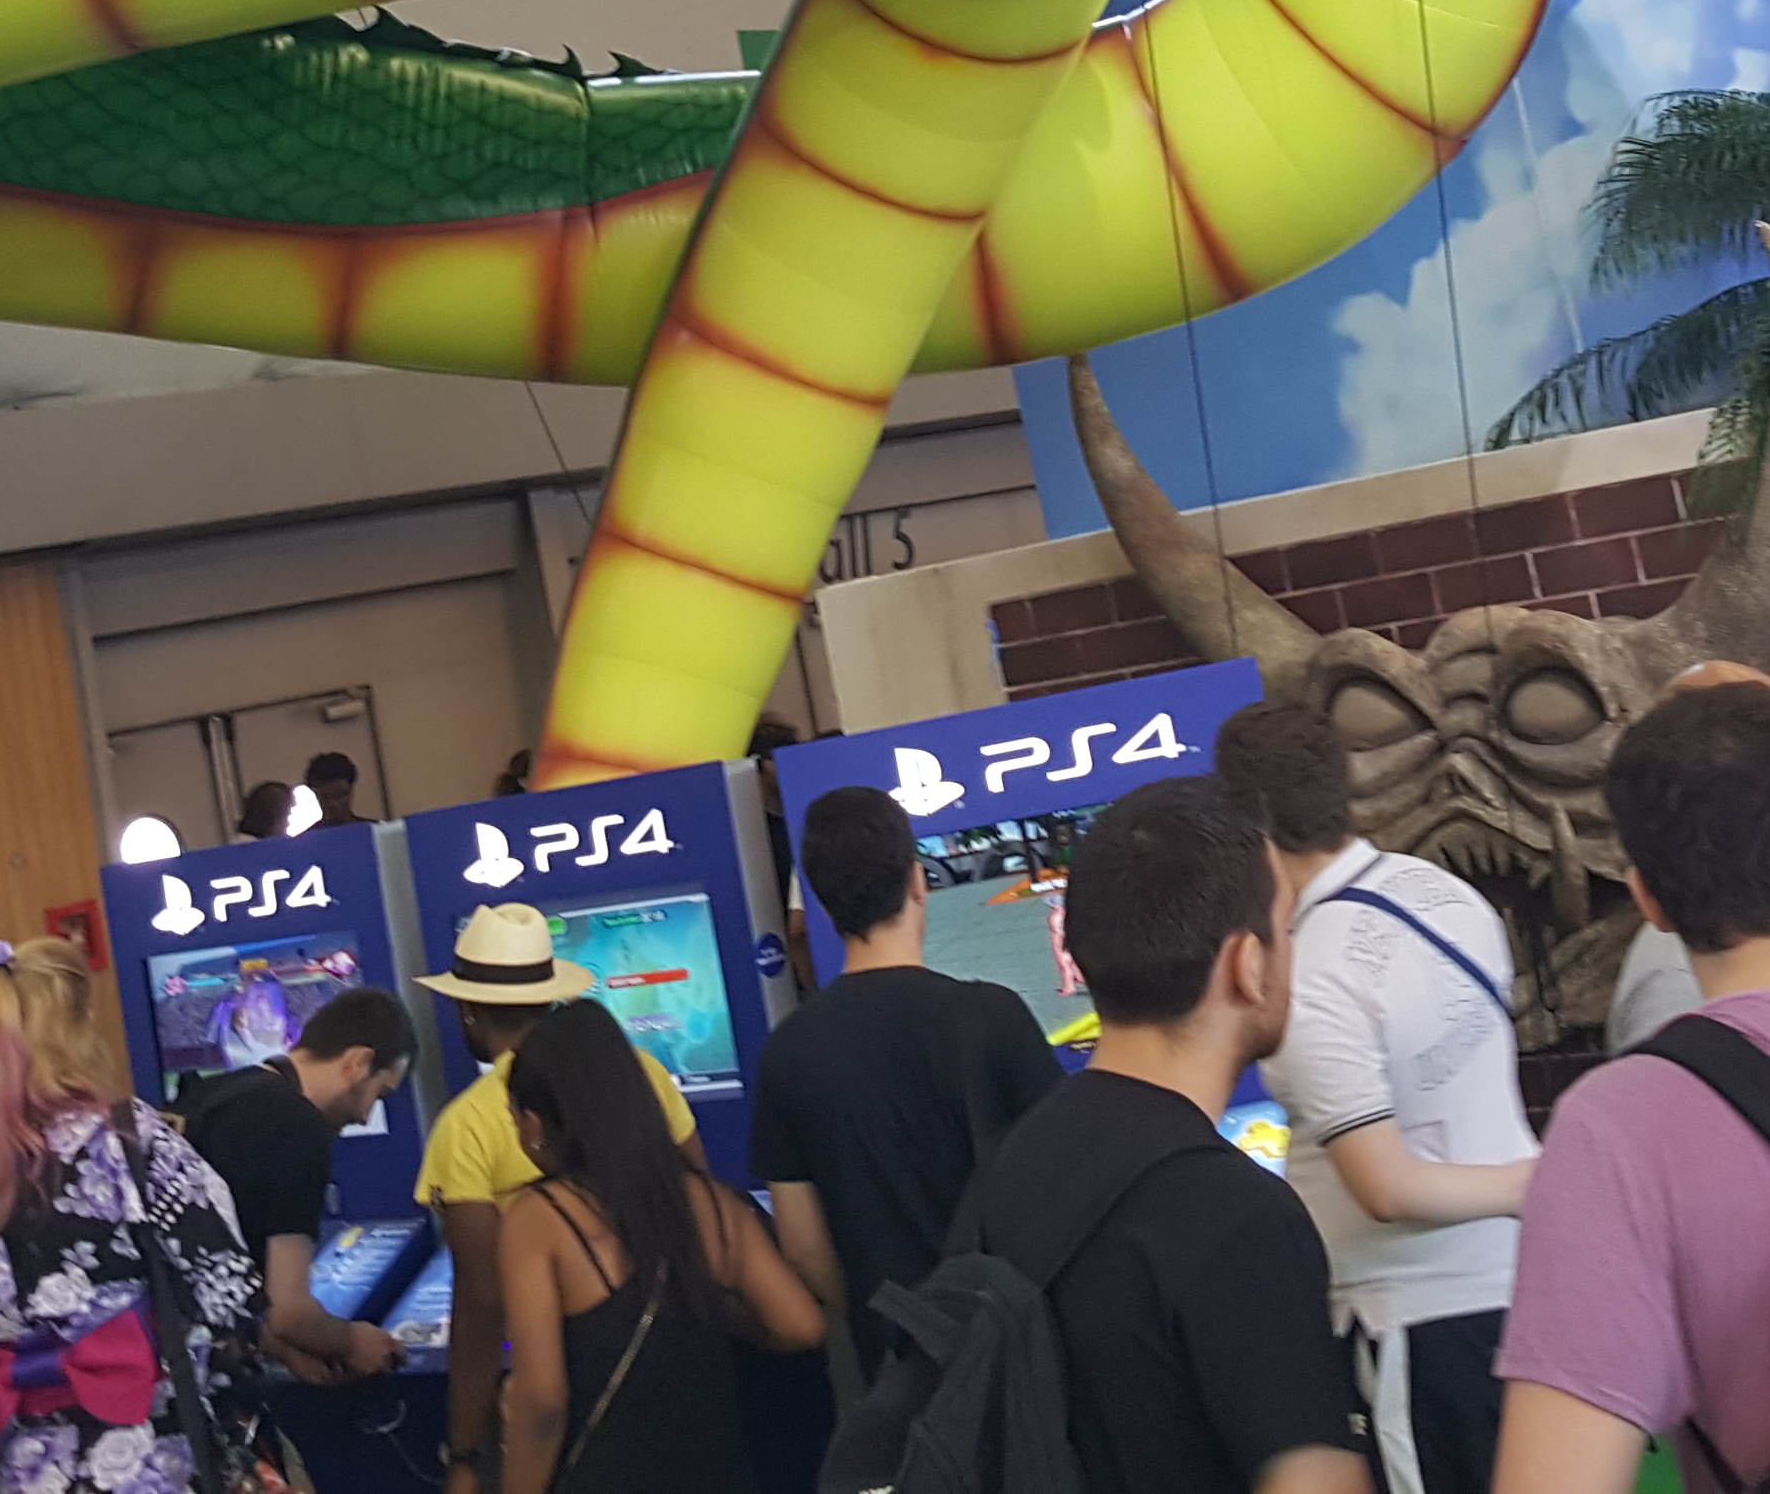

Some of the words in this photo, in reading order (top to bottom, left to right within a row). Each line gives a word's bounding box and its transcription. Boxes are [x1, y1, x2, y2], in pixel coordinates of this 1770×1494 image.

[818, 512, 872, 585] all
[890, 506, 916, 571] 5
[979, 712, 1188, 794] PS4
[529, 807, 675, 873] PS4
[209, 864, 332, 923] PS4
